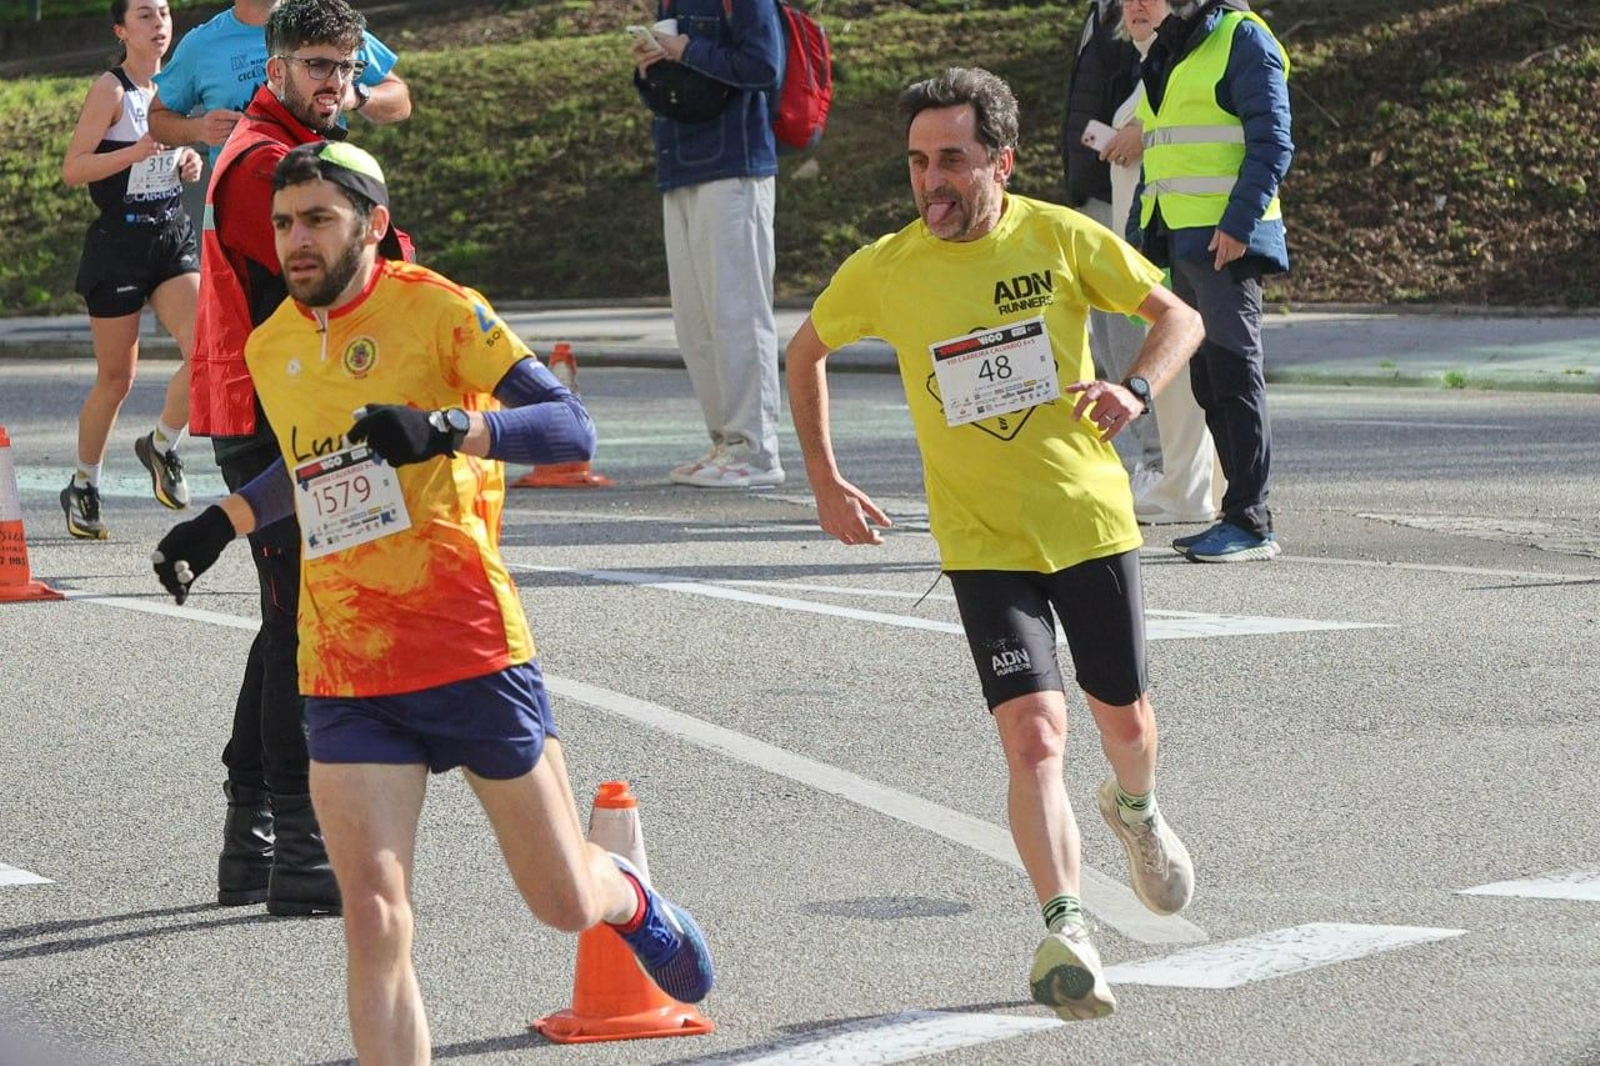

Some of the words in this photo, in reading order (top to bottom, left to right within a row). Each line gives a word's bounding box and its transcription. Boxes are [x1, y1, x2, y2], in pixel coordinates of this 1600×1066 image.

[994, 269, 1053, 305] ADN
[998, 295, 1053, 315] RUNNERS
[958, 350, 990, 363] CARREIRA
[990, 342, 1022, 355] CALVARIO
[978, 355, 1012, 382] 48
[312, 475, 371, 516] 1579
[992, 647, 1030, 671] ADN
